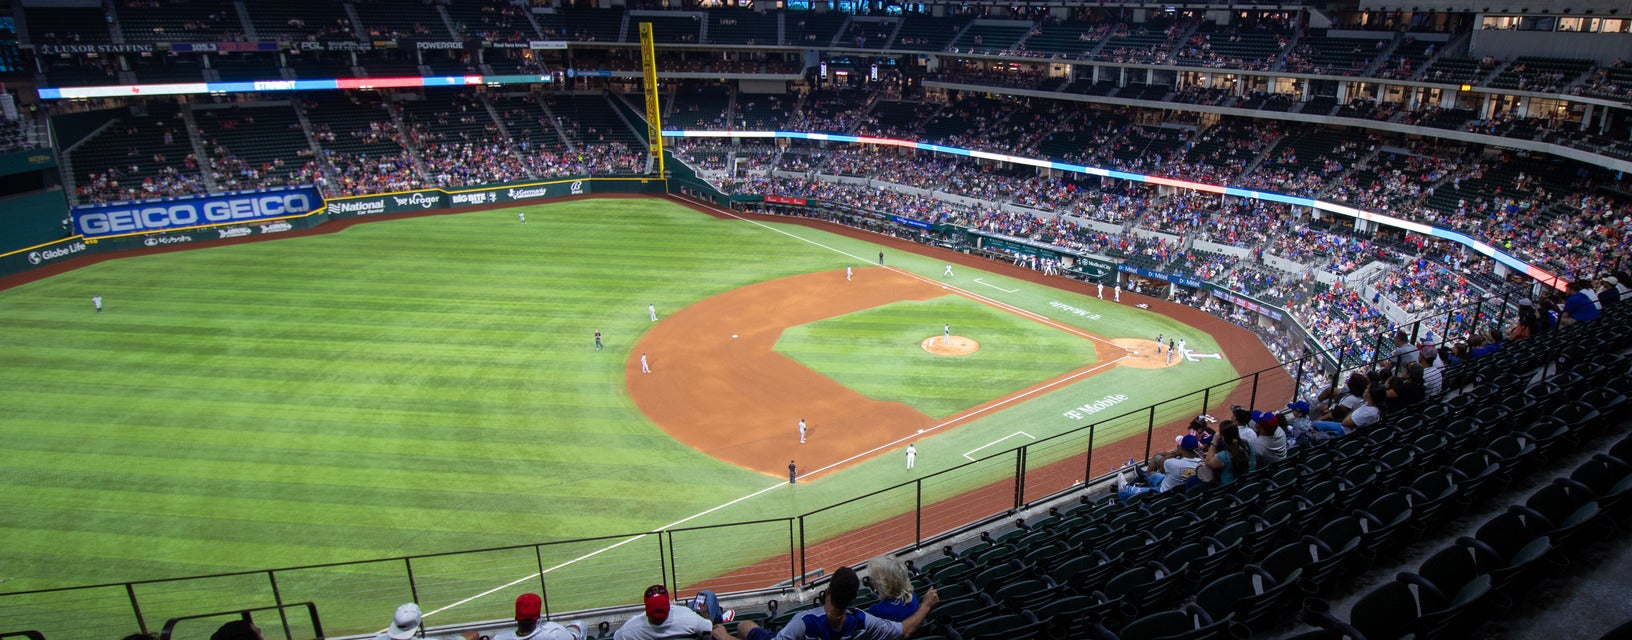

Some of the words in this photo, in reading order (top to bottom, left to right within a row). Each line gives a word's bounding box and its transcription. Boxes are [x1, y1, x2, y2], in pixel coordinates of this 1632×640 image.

[54, 45, 95, 53] LUXOR
[98, 44, 153, 52] STAFFING
[192, 43, 217, 51] 105.3
[301, 42, 324, 50] PGL
[416, 41, 464, 49] POWERADE
[409, 193, 439, 208] Kroger
[468, 192, 486, 202] BITE
[341, 199, 384, 212] National
[79, 204, 198, 235] GEICO
[204, 193, 309, 221] GEICO
[159, 235, 192, 244] Kubota
[42, 248, 69, 260] Globe
[69, 242, 86, 253] Life
[1125, 265, 1138, 274] Mitel
[1155, 272, 1169, 281] Mitel
[1076, 393, 1128, 415] Mobile
